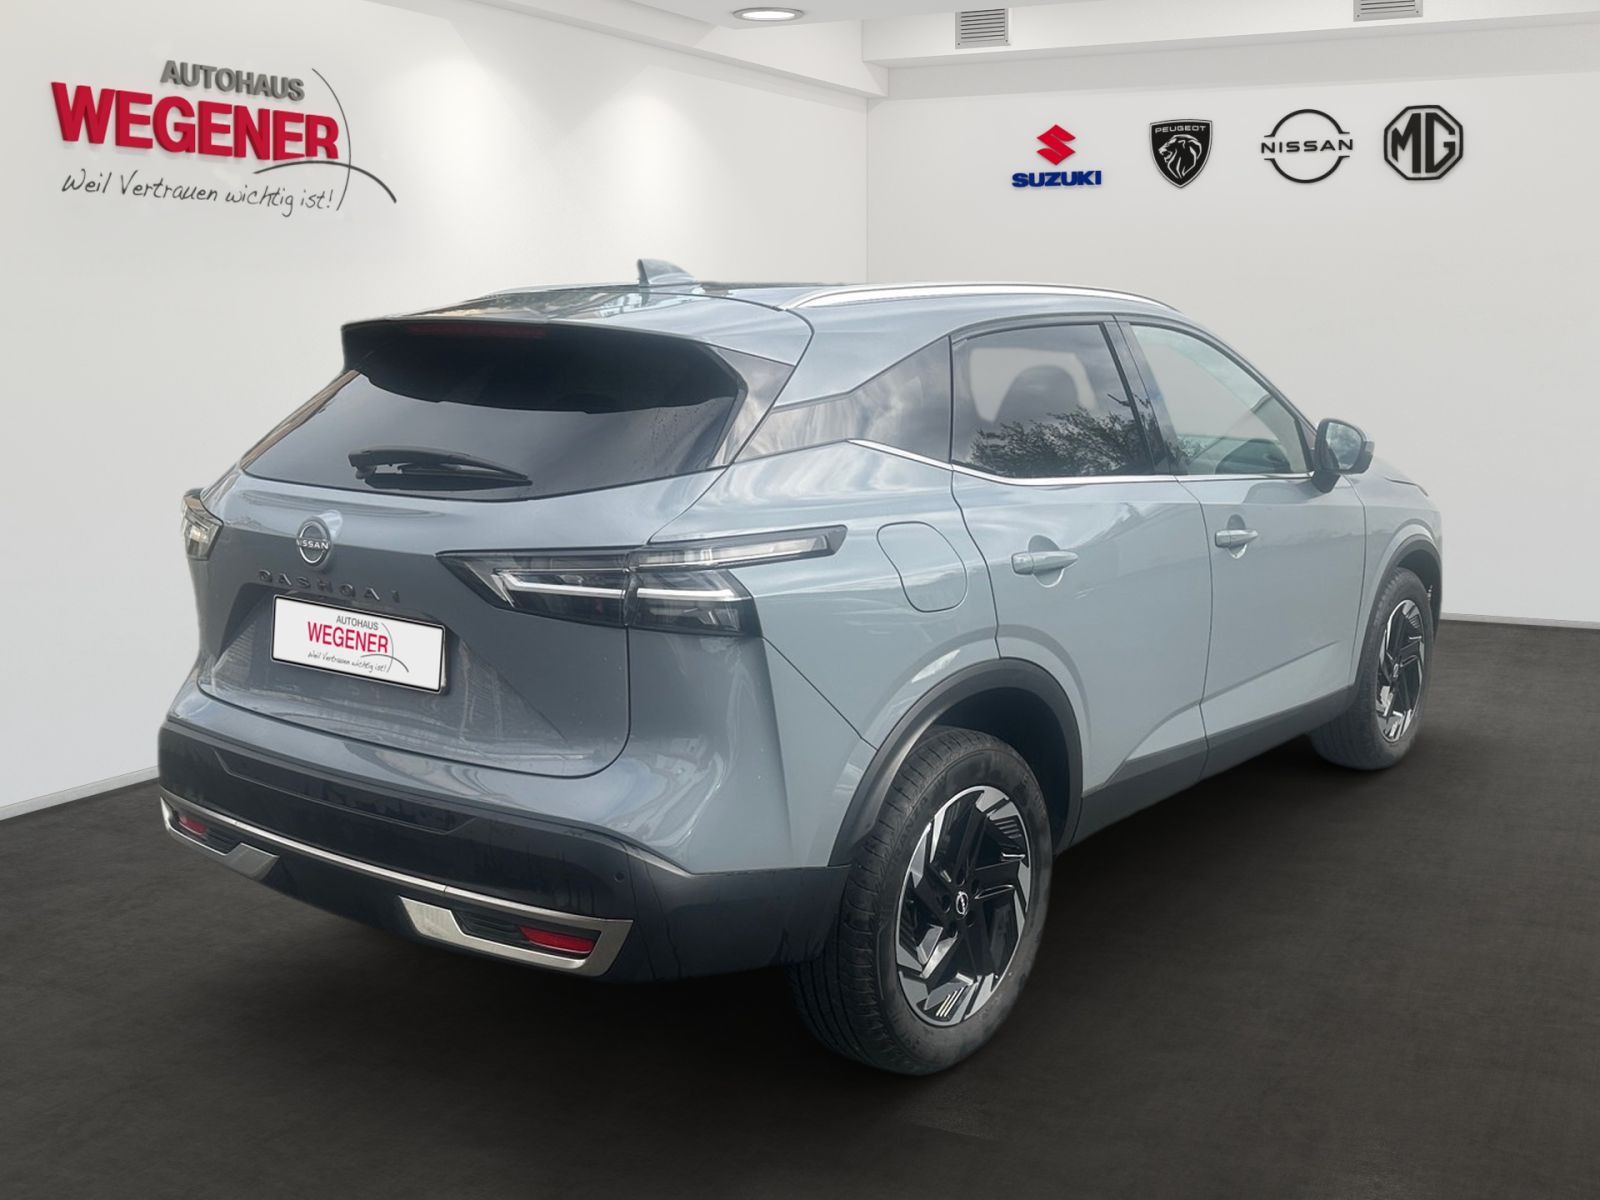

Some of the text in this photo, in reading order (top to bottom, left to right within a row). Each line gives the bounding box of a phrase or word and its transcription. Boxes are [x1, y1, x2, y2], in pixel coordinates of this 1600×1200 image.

[160, 60, 305, 101] AUTOHAUS
[51, 82, 340, 161] WEGENER
[1155, 125, 1207, 134] PEUGEOT
[1261, 139, 1353, 154] NISSAN
[1391, 112, 1456, 174] MG
[61, 168, 334, 218] Weil Vertrauen wichtig ist!
[1012, 170, 1102, 187] SUZUKI
[258, 569, 400, 602] QASHQAI
[307, 621, 388, 653] WEGENER
[336, 615, 379, 630] AUTOHAUS
